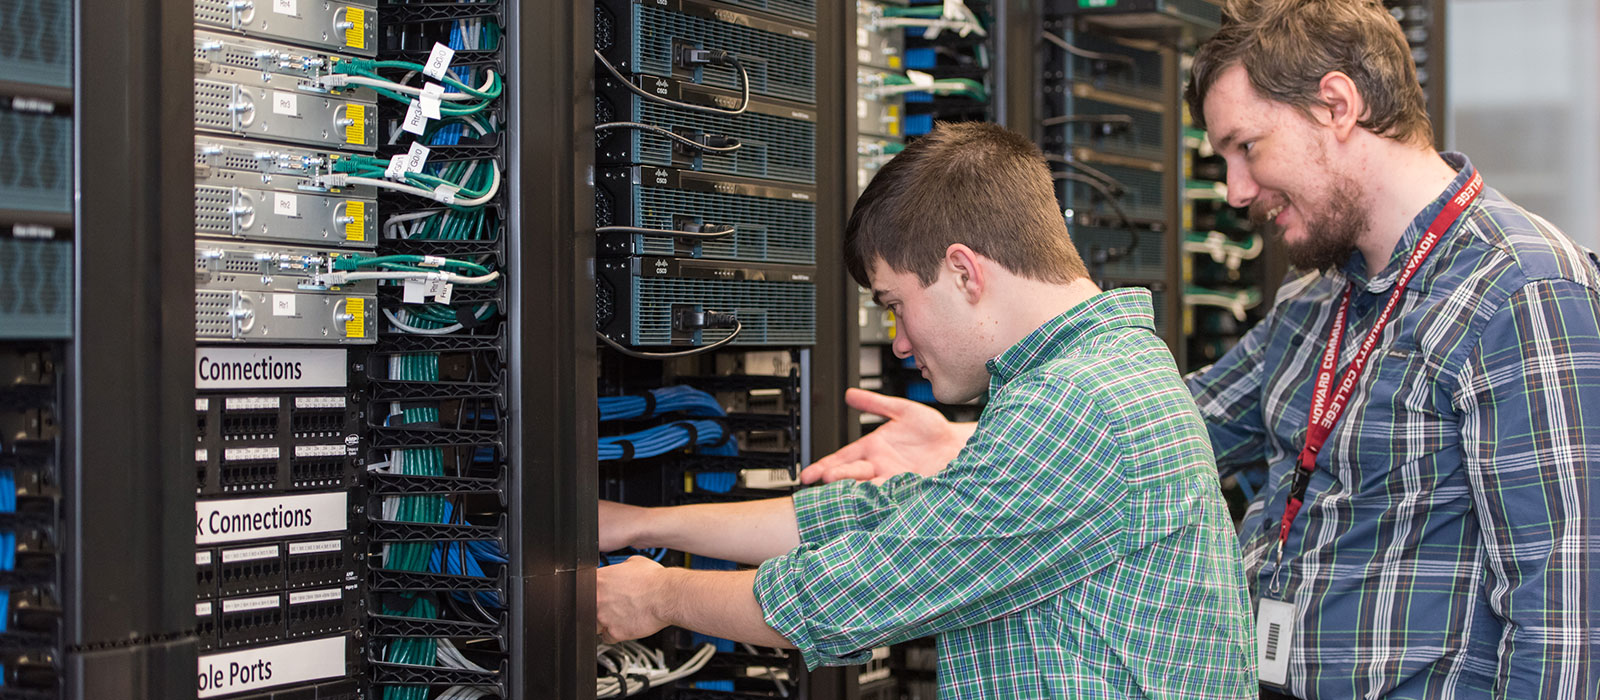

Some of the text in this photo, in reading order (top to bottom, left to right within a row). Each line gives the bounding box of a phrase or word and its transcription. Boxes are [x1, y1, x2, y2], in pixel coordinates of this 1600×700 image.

[1398, 231, 1438, 287] HOWARD
[1355, 289, 1400, 369] COMMUNITY
[199, 355, 302, 381] Connections
[1320, 369, 1357, 430] COLLEGE
[209, 504, 312, 534] Connections
[229, 659, 272, 686] Ports
